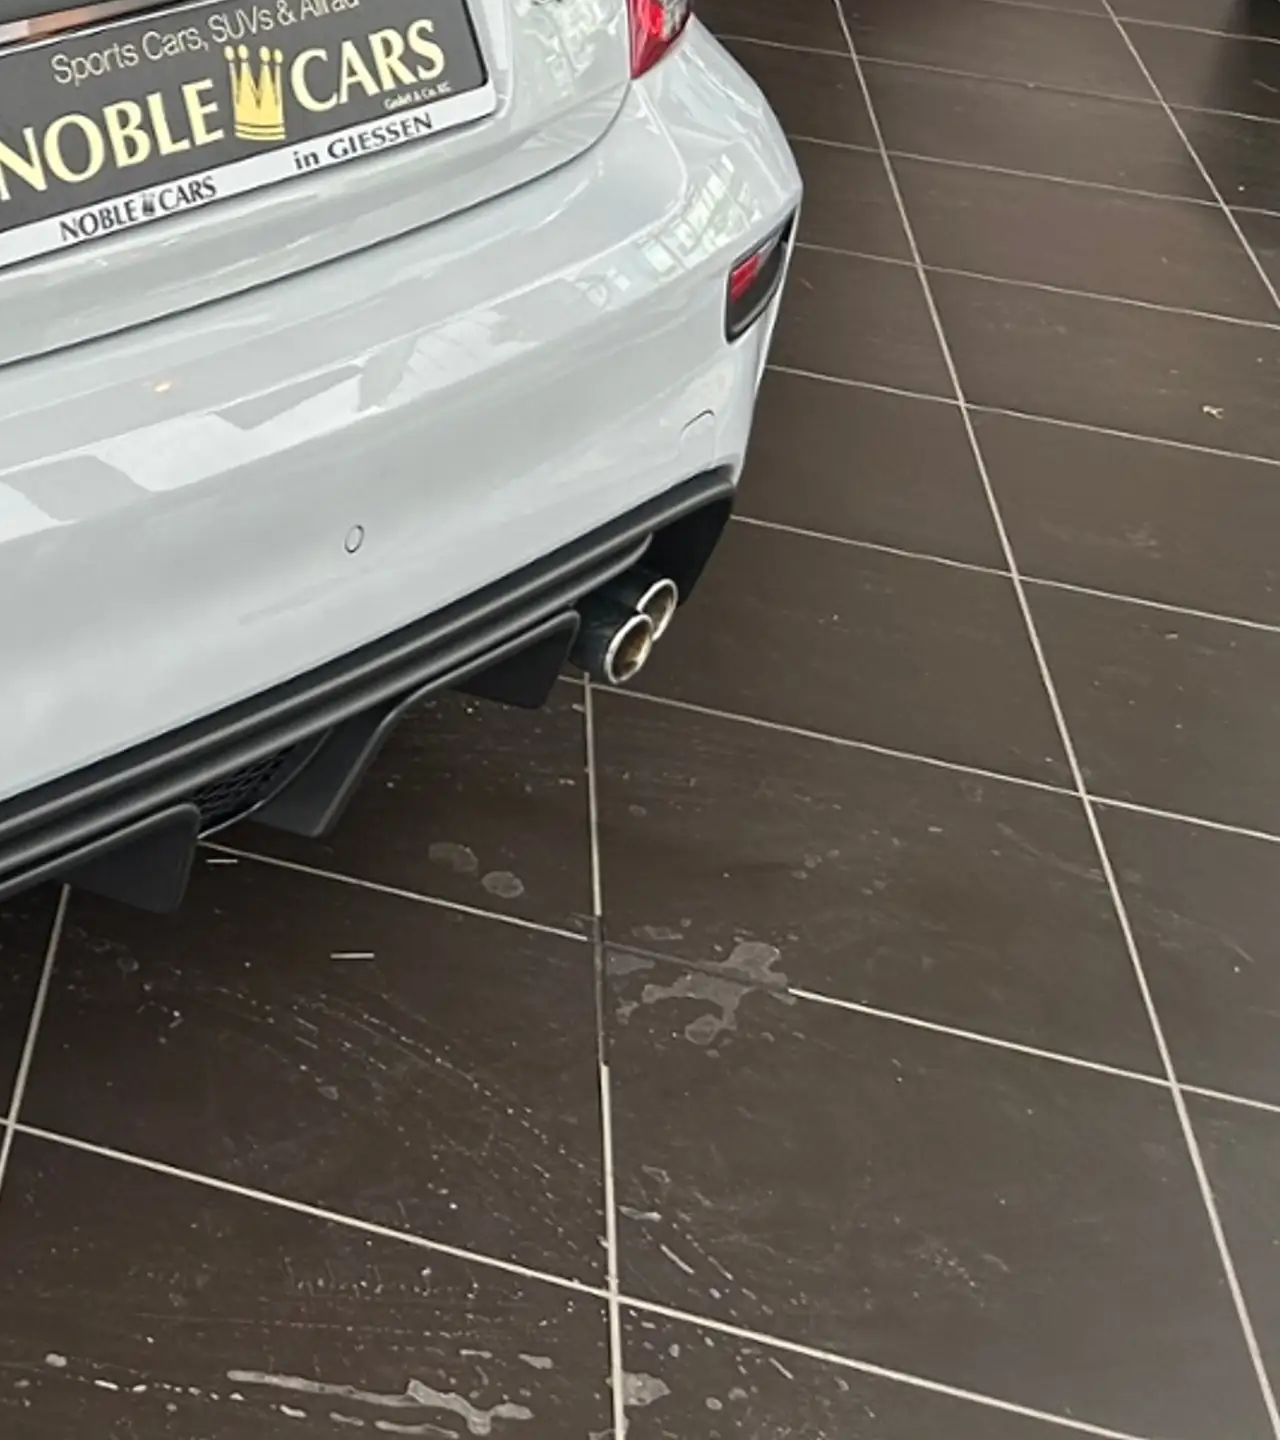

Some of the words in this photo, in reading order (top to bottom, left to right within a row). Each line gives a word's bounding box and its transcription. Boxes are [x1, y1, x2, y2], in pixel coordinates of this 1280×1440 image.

[51, 43, 140, 86] Sports
[142, 25, 209, 62] Cars,
[207, 6, 274, 43] SUVs
[277, 0, 297, 26] &
[290, 19, 444, 112] CARS
[293, 150, 320, 171] in
[328, 112, 434, 161] GIESSEN
[59, 199, 139, 242] NOBLE
[158, 176, 218, 212] CARS
